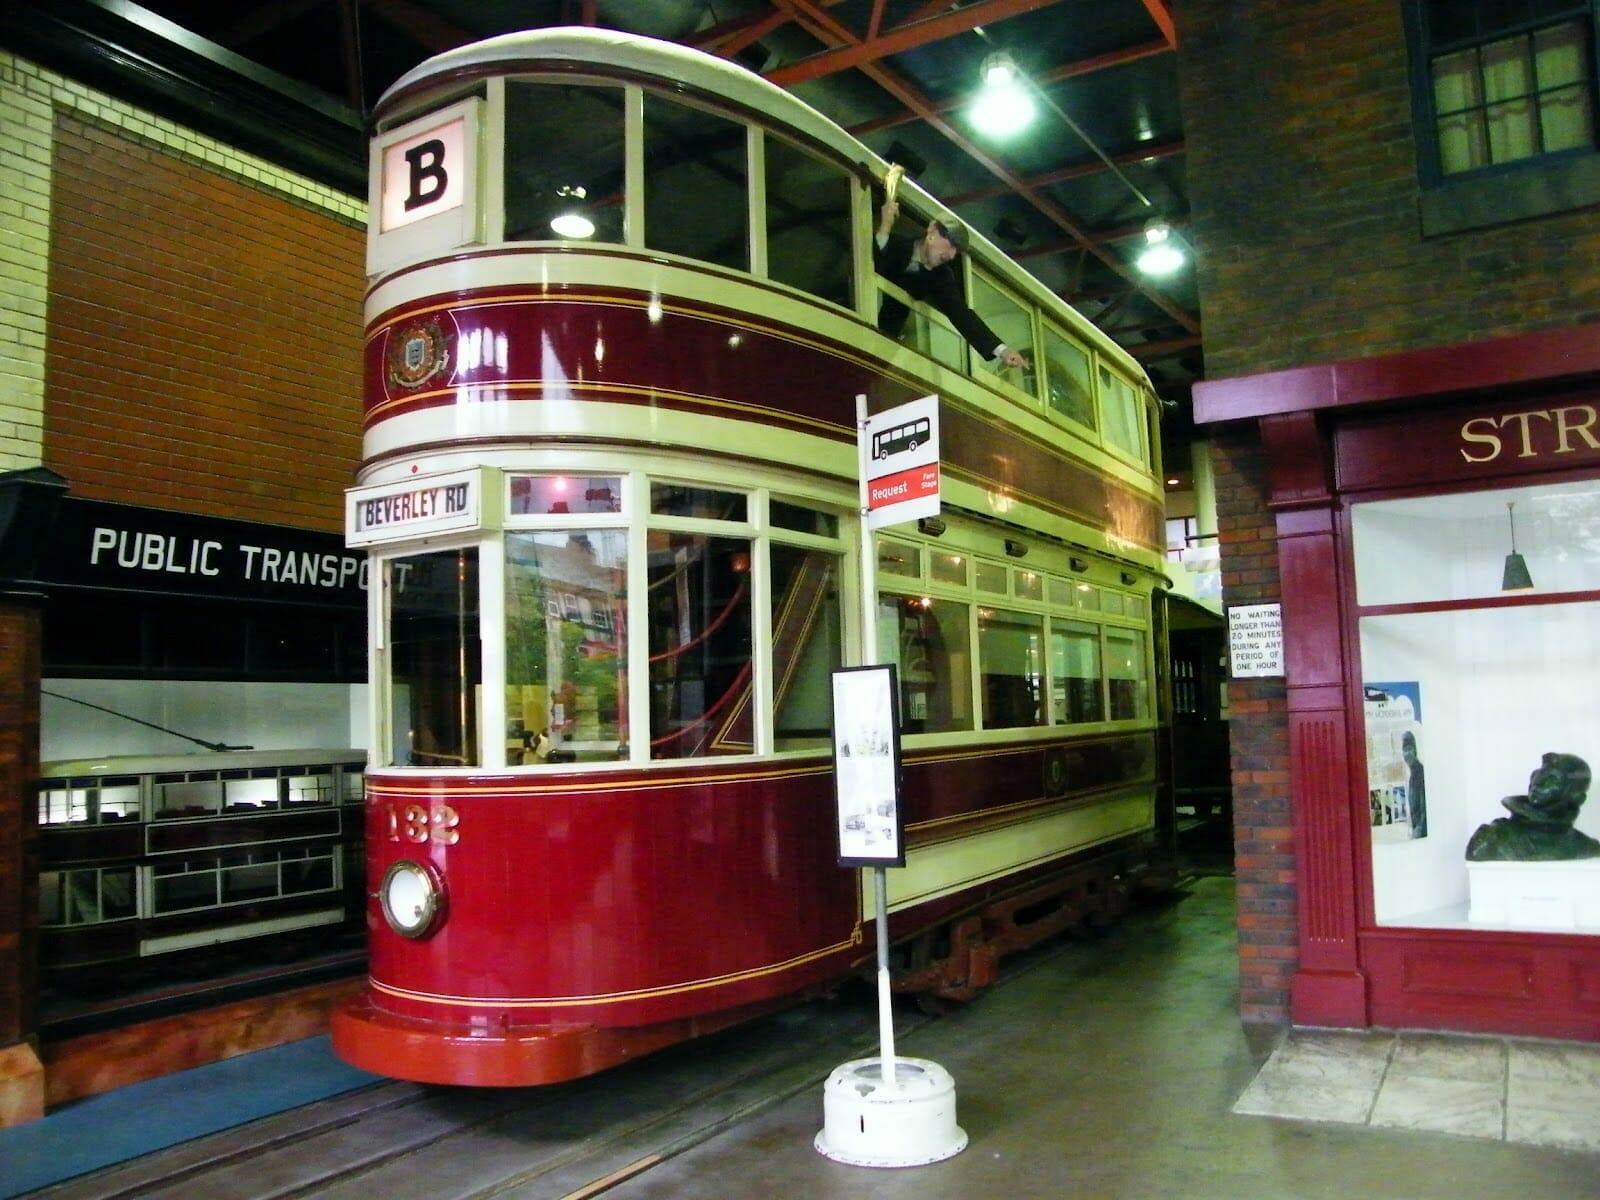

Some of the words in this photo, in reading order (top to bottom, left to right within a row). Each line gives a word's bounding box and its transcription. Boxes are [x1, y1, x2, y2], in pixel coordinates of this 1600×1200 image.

[404, 139, 448, 213] B
[1460, 405, 1600, 463] STR
[872, 481, 908, 501] Request
[365, 489, 439, 526] BEVERLEY
[445, 485, 467, 513] RD
[90, 527, 222, 576] PUBLIC
[1248, 610, 1280, 619] WAITING
[1230, 622, 1258, 631] LONGER
[1260, 621, 1281, 629] THAN
[1232, 632, 1243, 640] 20
[1247, 630, 1281, 639] MINUTES
[1232, 643, 1260, 651] DURING
[1265, 641, 1281, 649] ANY
[1236, 652, 1264, 661] PERIOD
[1269, 650, 1280, 659] OF
[1236, 663, 1252, 671] ONE
[1256, 661, 1278, 670] HOUR
[387, 804, 460, 846] 132
